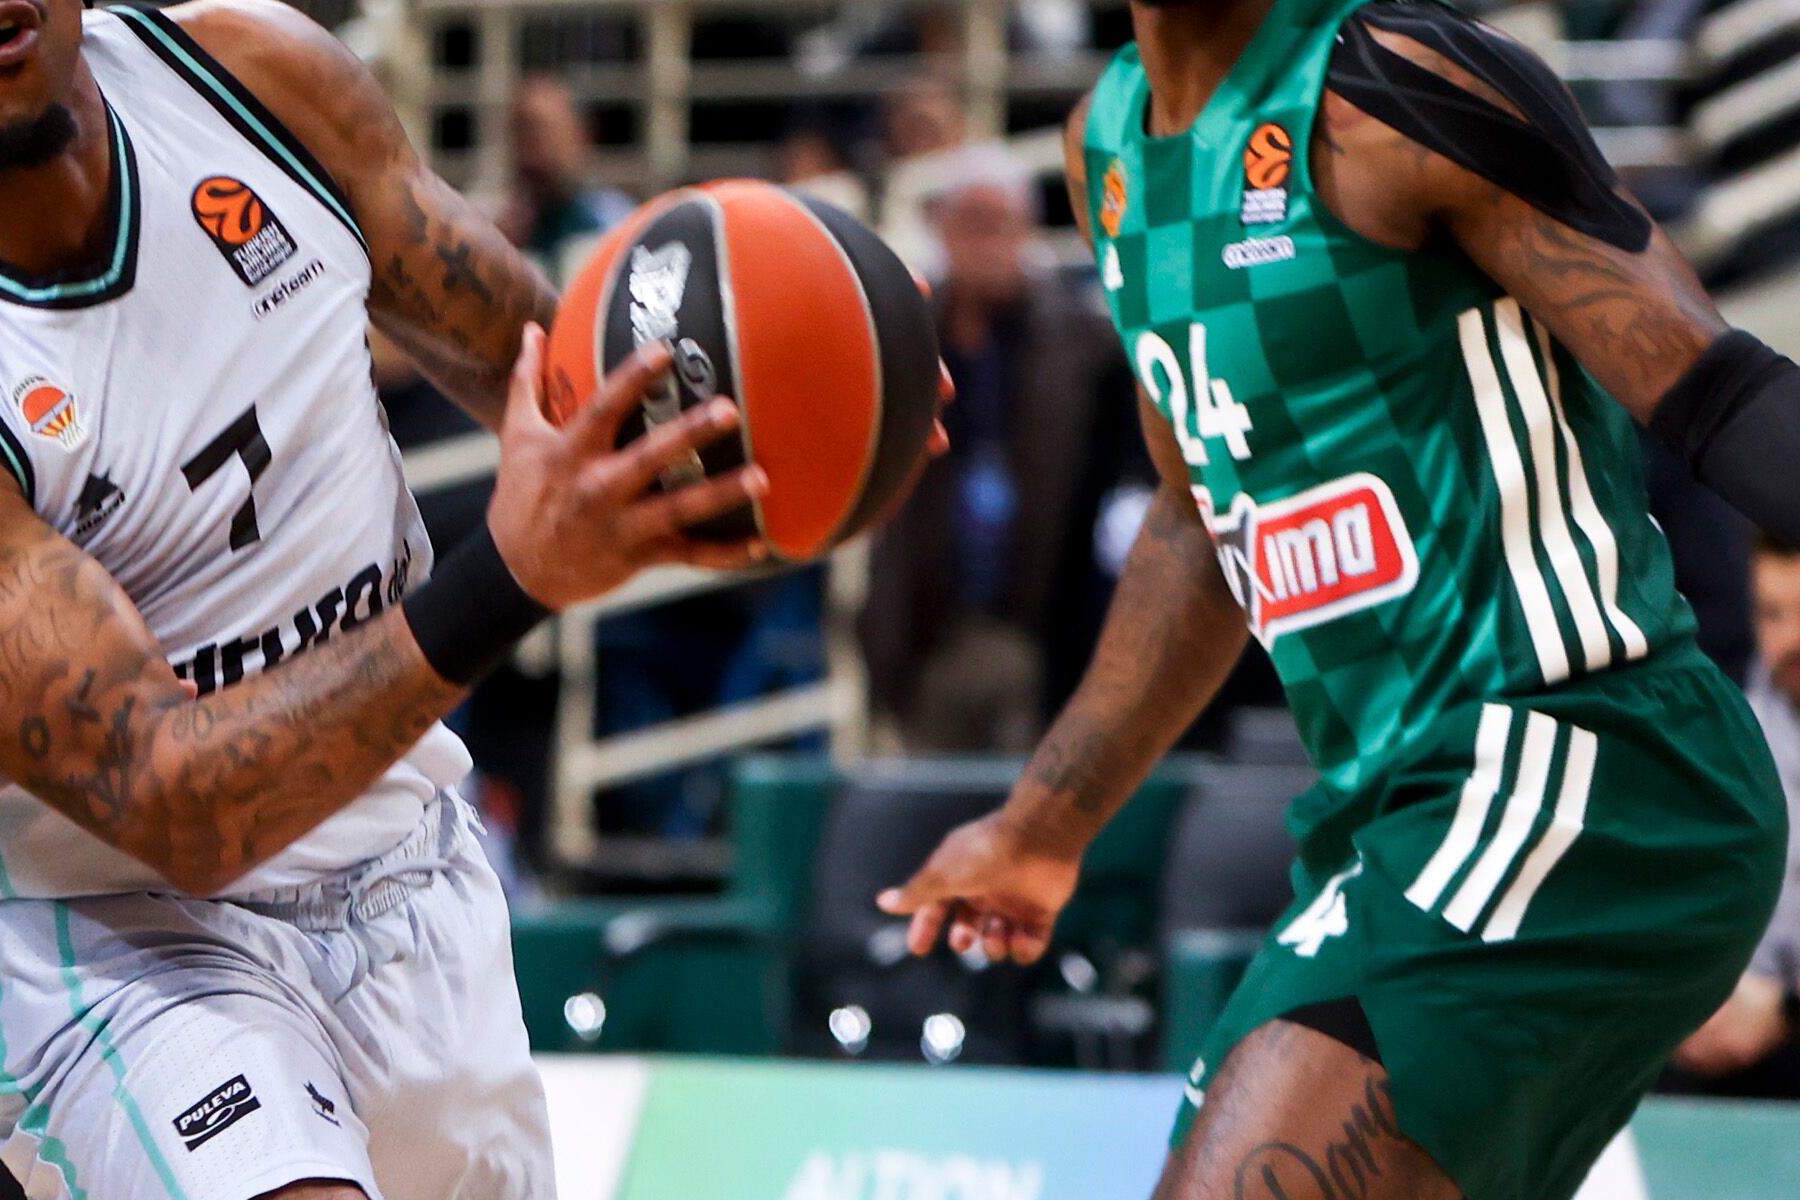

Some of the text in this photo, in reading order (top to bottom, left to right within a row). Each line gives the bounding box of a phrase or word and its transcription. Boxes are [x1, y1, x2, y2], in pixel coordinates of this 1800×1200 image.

[1136, 322, 1253, 466] 24
[181, 403, 272, 552] 7
[178, 1080, 247, 1131] PULEVA
